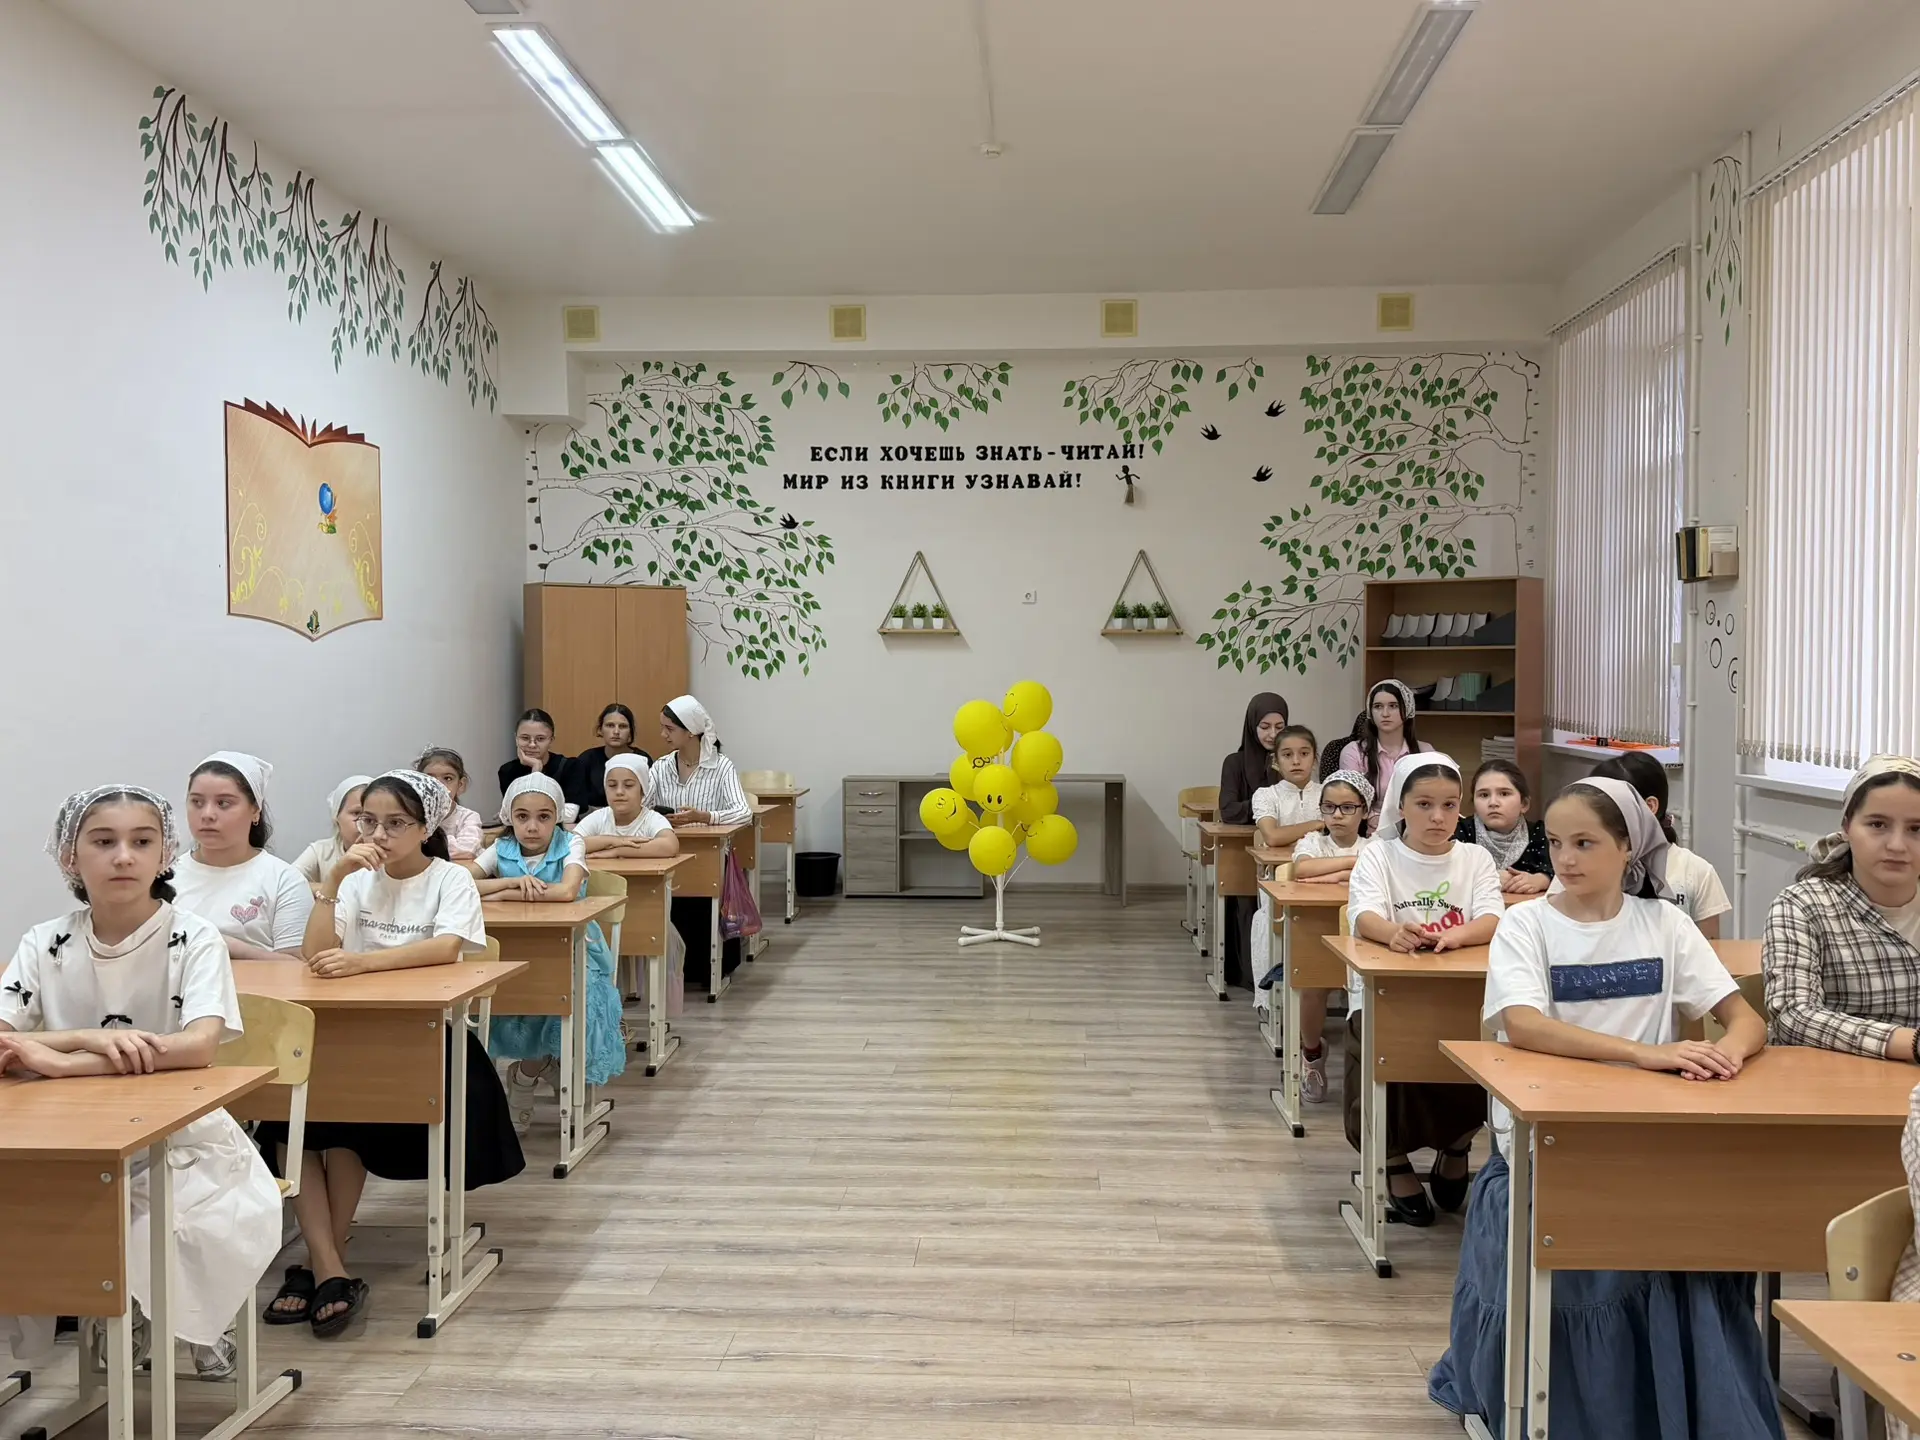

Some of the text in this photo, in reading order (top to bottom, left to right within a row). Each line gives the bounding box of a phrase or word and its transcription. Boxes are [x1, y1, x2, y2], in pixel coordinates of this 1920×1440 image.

[810, 446, 868, 462] ЕСЛИ
[879, 445, 965, 462] ХОЧЕШЬ
[782, 470, 1082, 490] МИР ИЗ КНИГИ УЗНАВАЙ!
[1394, 897, 1464, 915] Naturally Sweet
